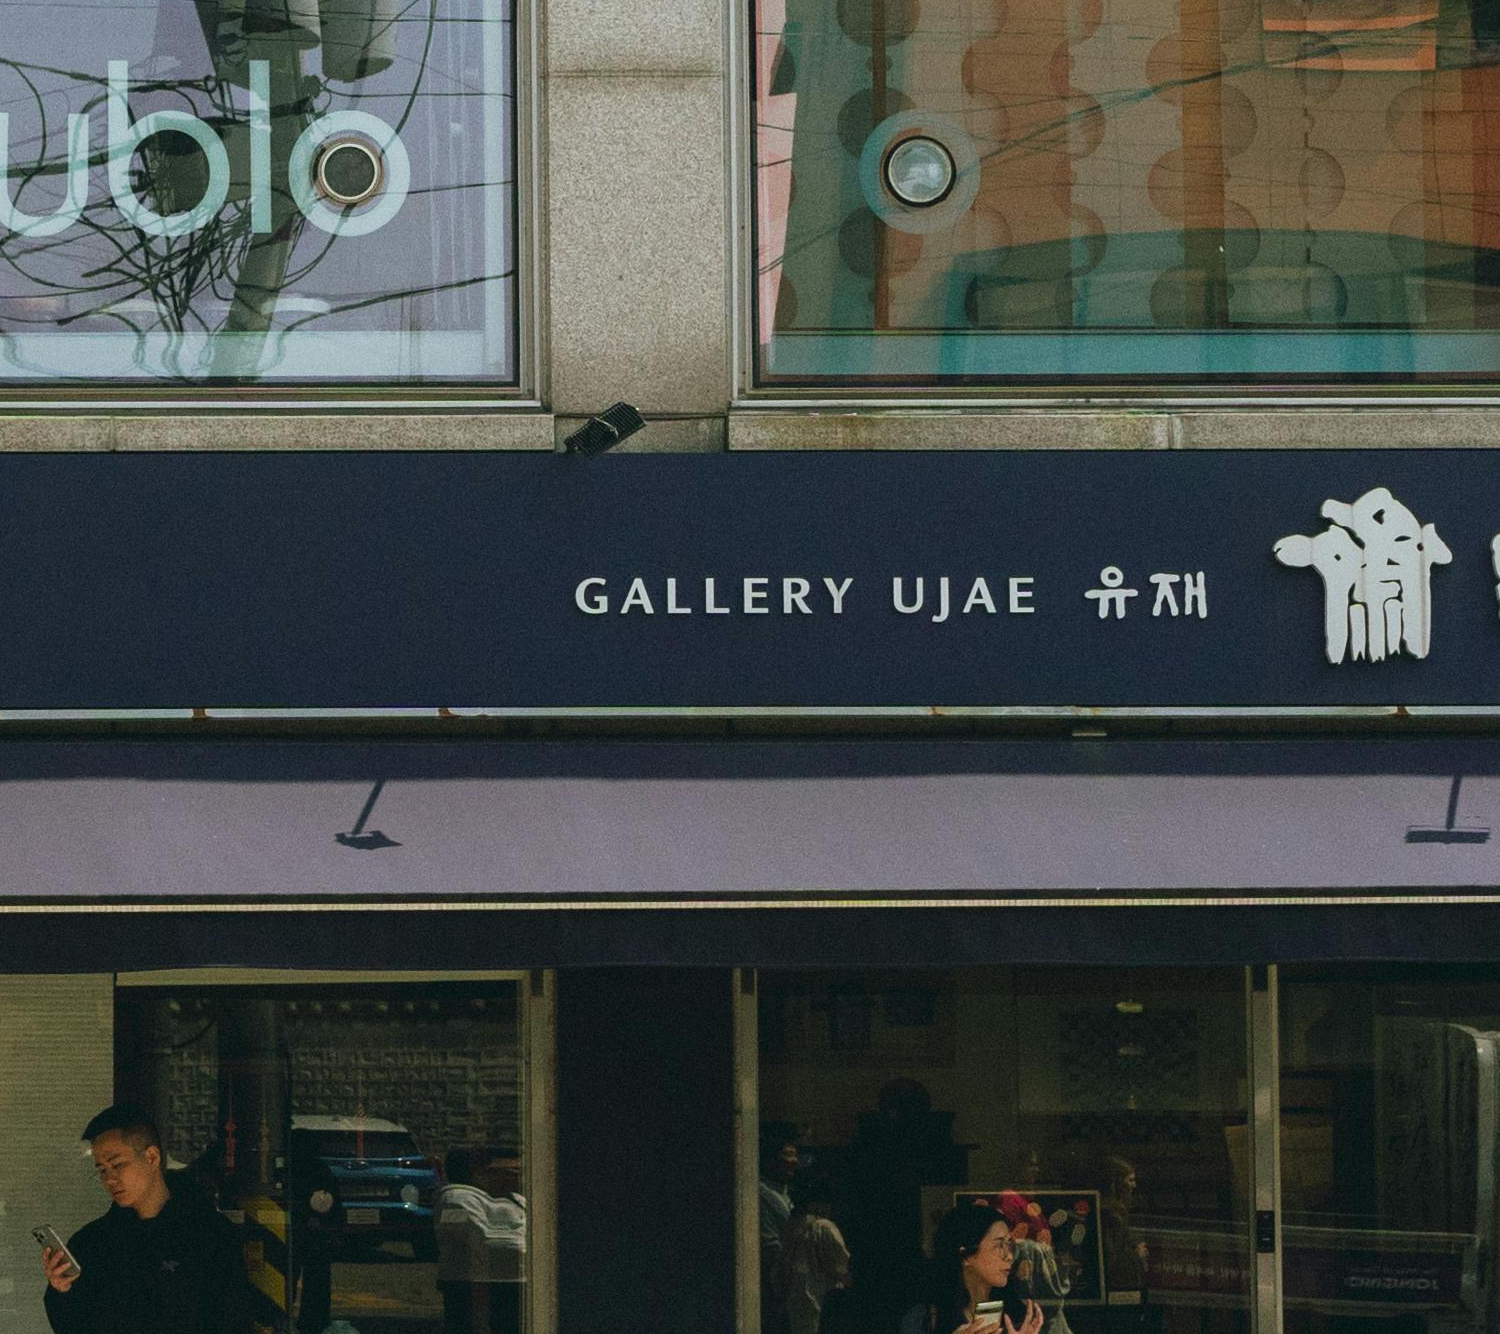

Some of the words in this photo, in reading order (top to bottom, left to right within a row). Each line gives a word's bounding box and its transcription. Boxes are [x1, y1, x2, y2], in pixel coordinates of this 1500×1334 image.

[575, 576, 854, 617] GALLERY
[891, 575, 1037, 623] UJAE
[1083, 564, 1208, 621] 유재
